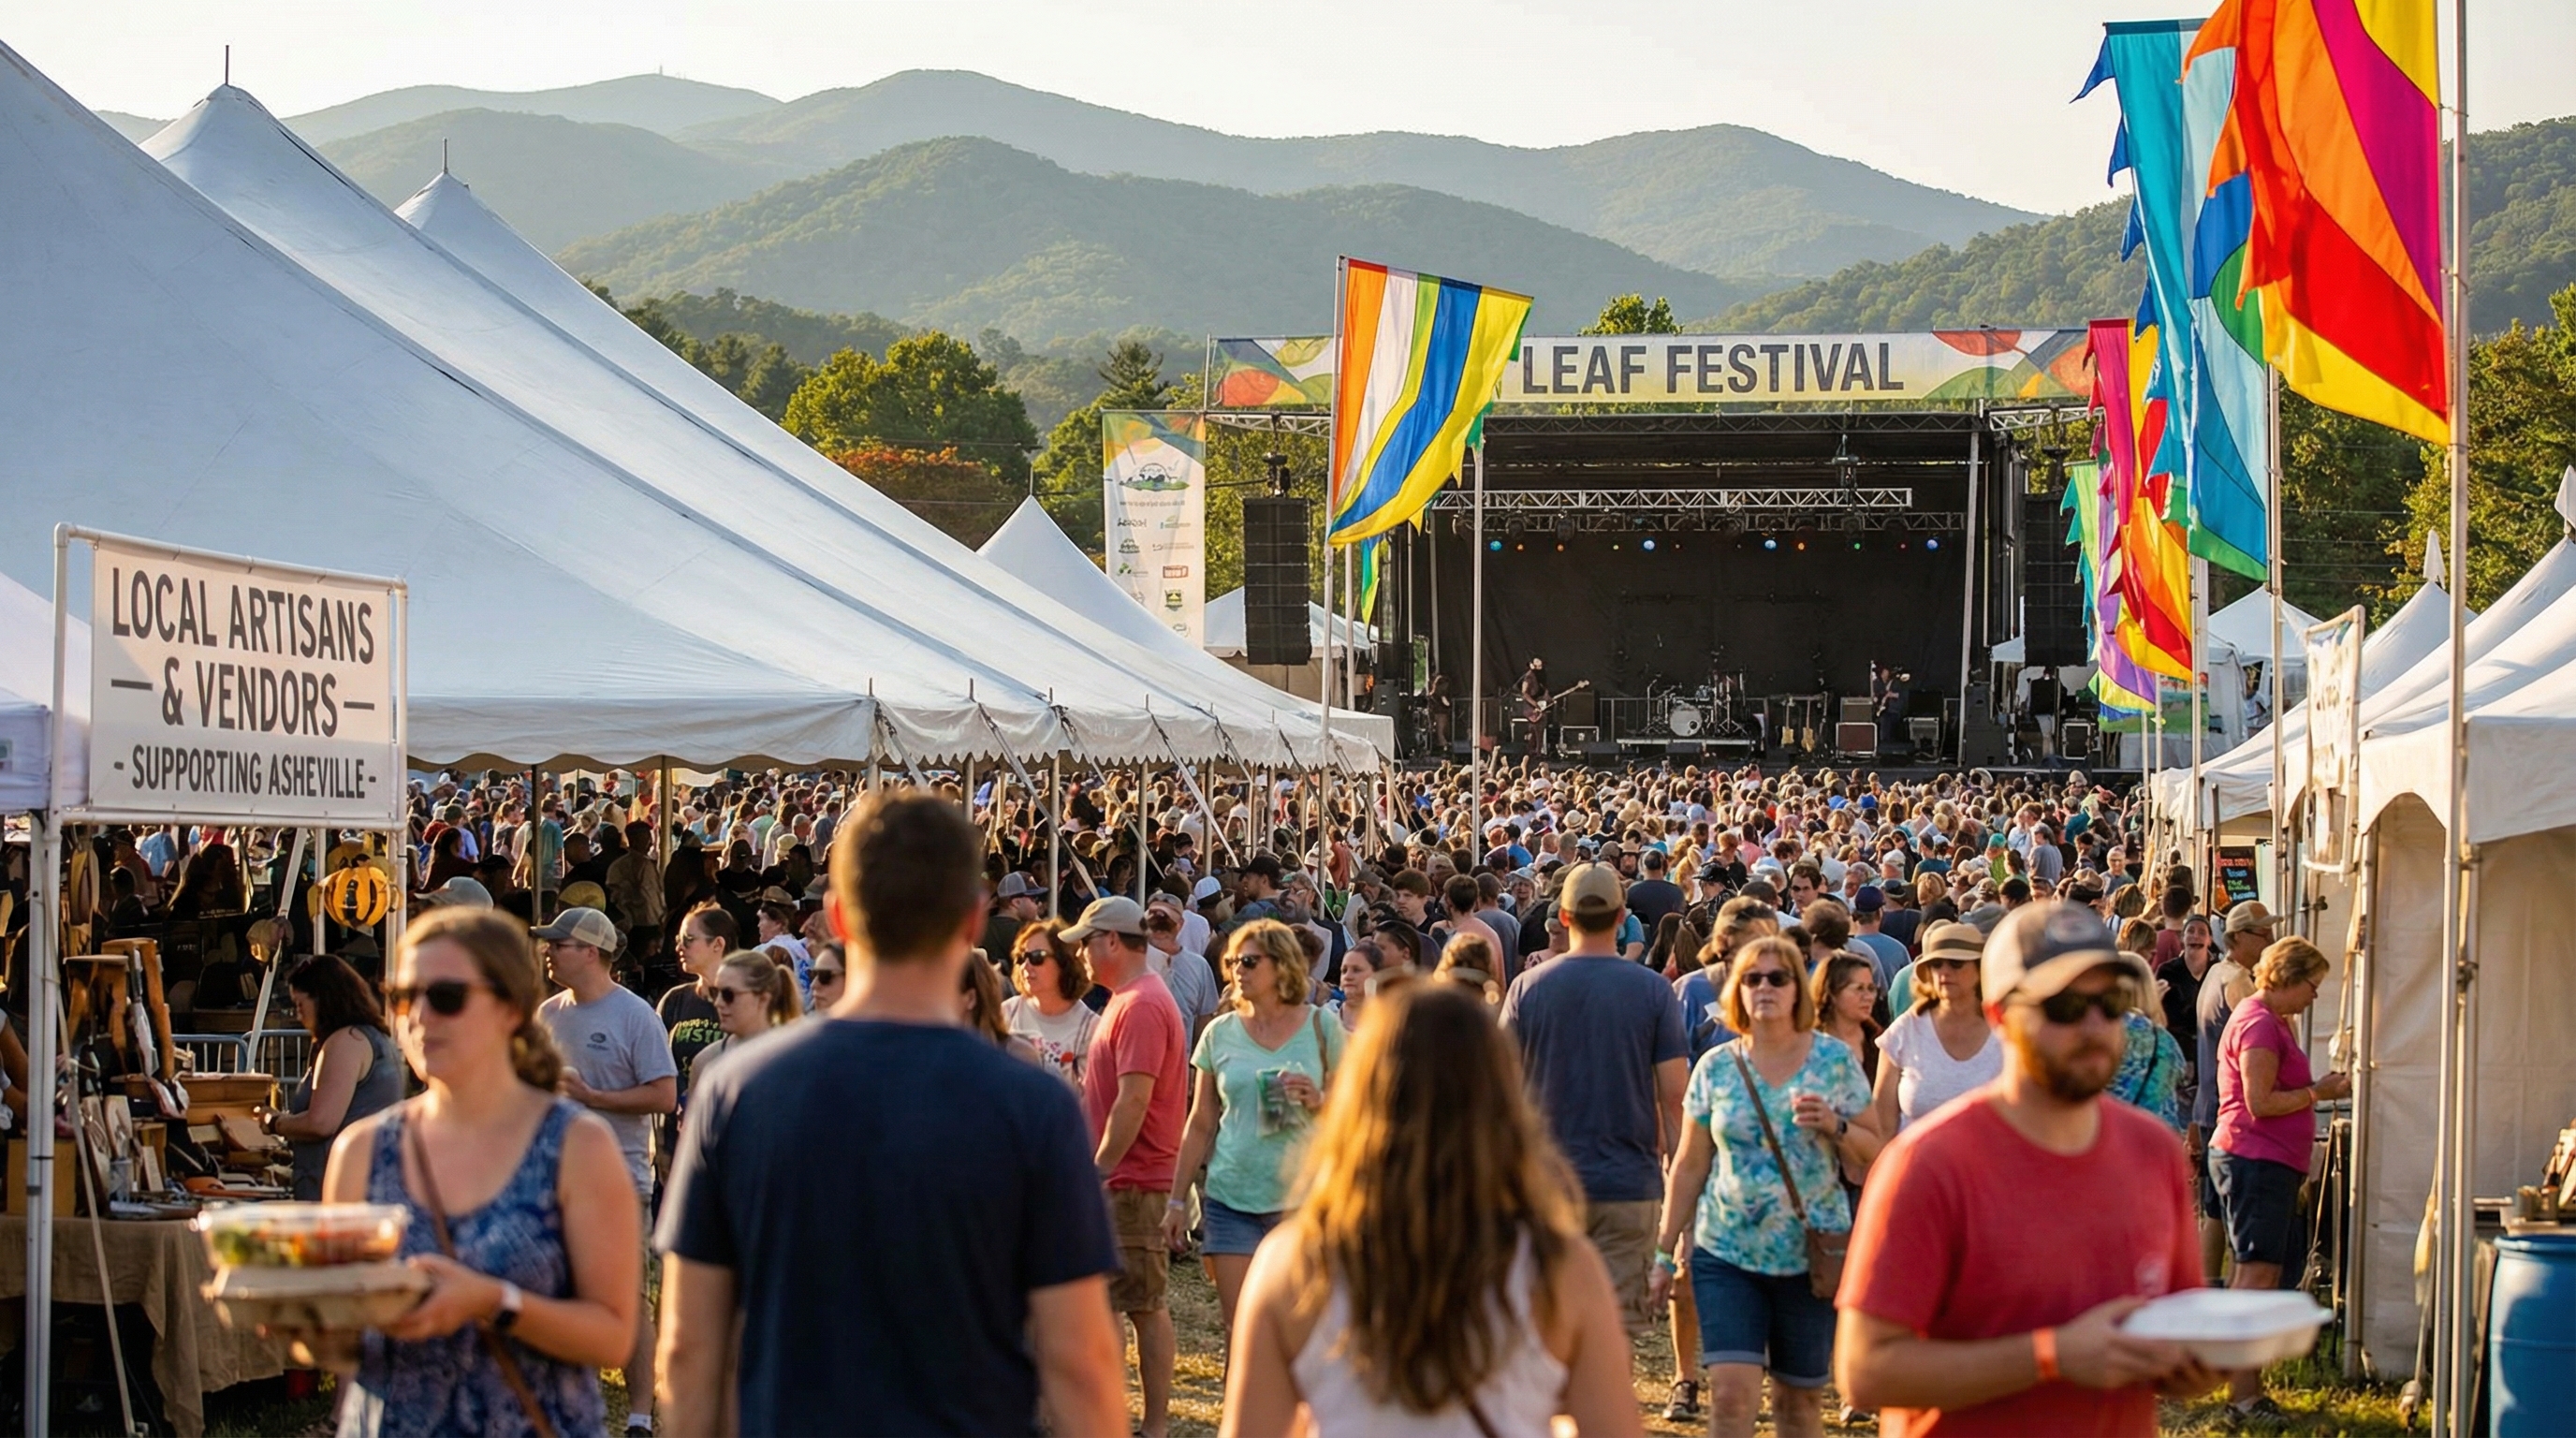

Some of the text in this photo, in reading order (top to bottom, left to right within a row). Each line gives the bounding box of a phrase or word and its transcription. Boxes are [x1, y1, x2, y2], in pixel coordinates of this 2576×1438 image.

[1523, 342, 1905, 394] LEAF FESTIVAL
[112, 566, 375, 665] LOCAL ARTISANS
[162, 656, 338, 738] & VENDORS
[132, 744, 366, 799] SUPPORTING ASHEVILLE
